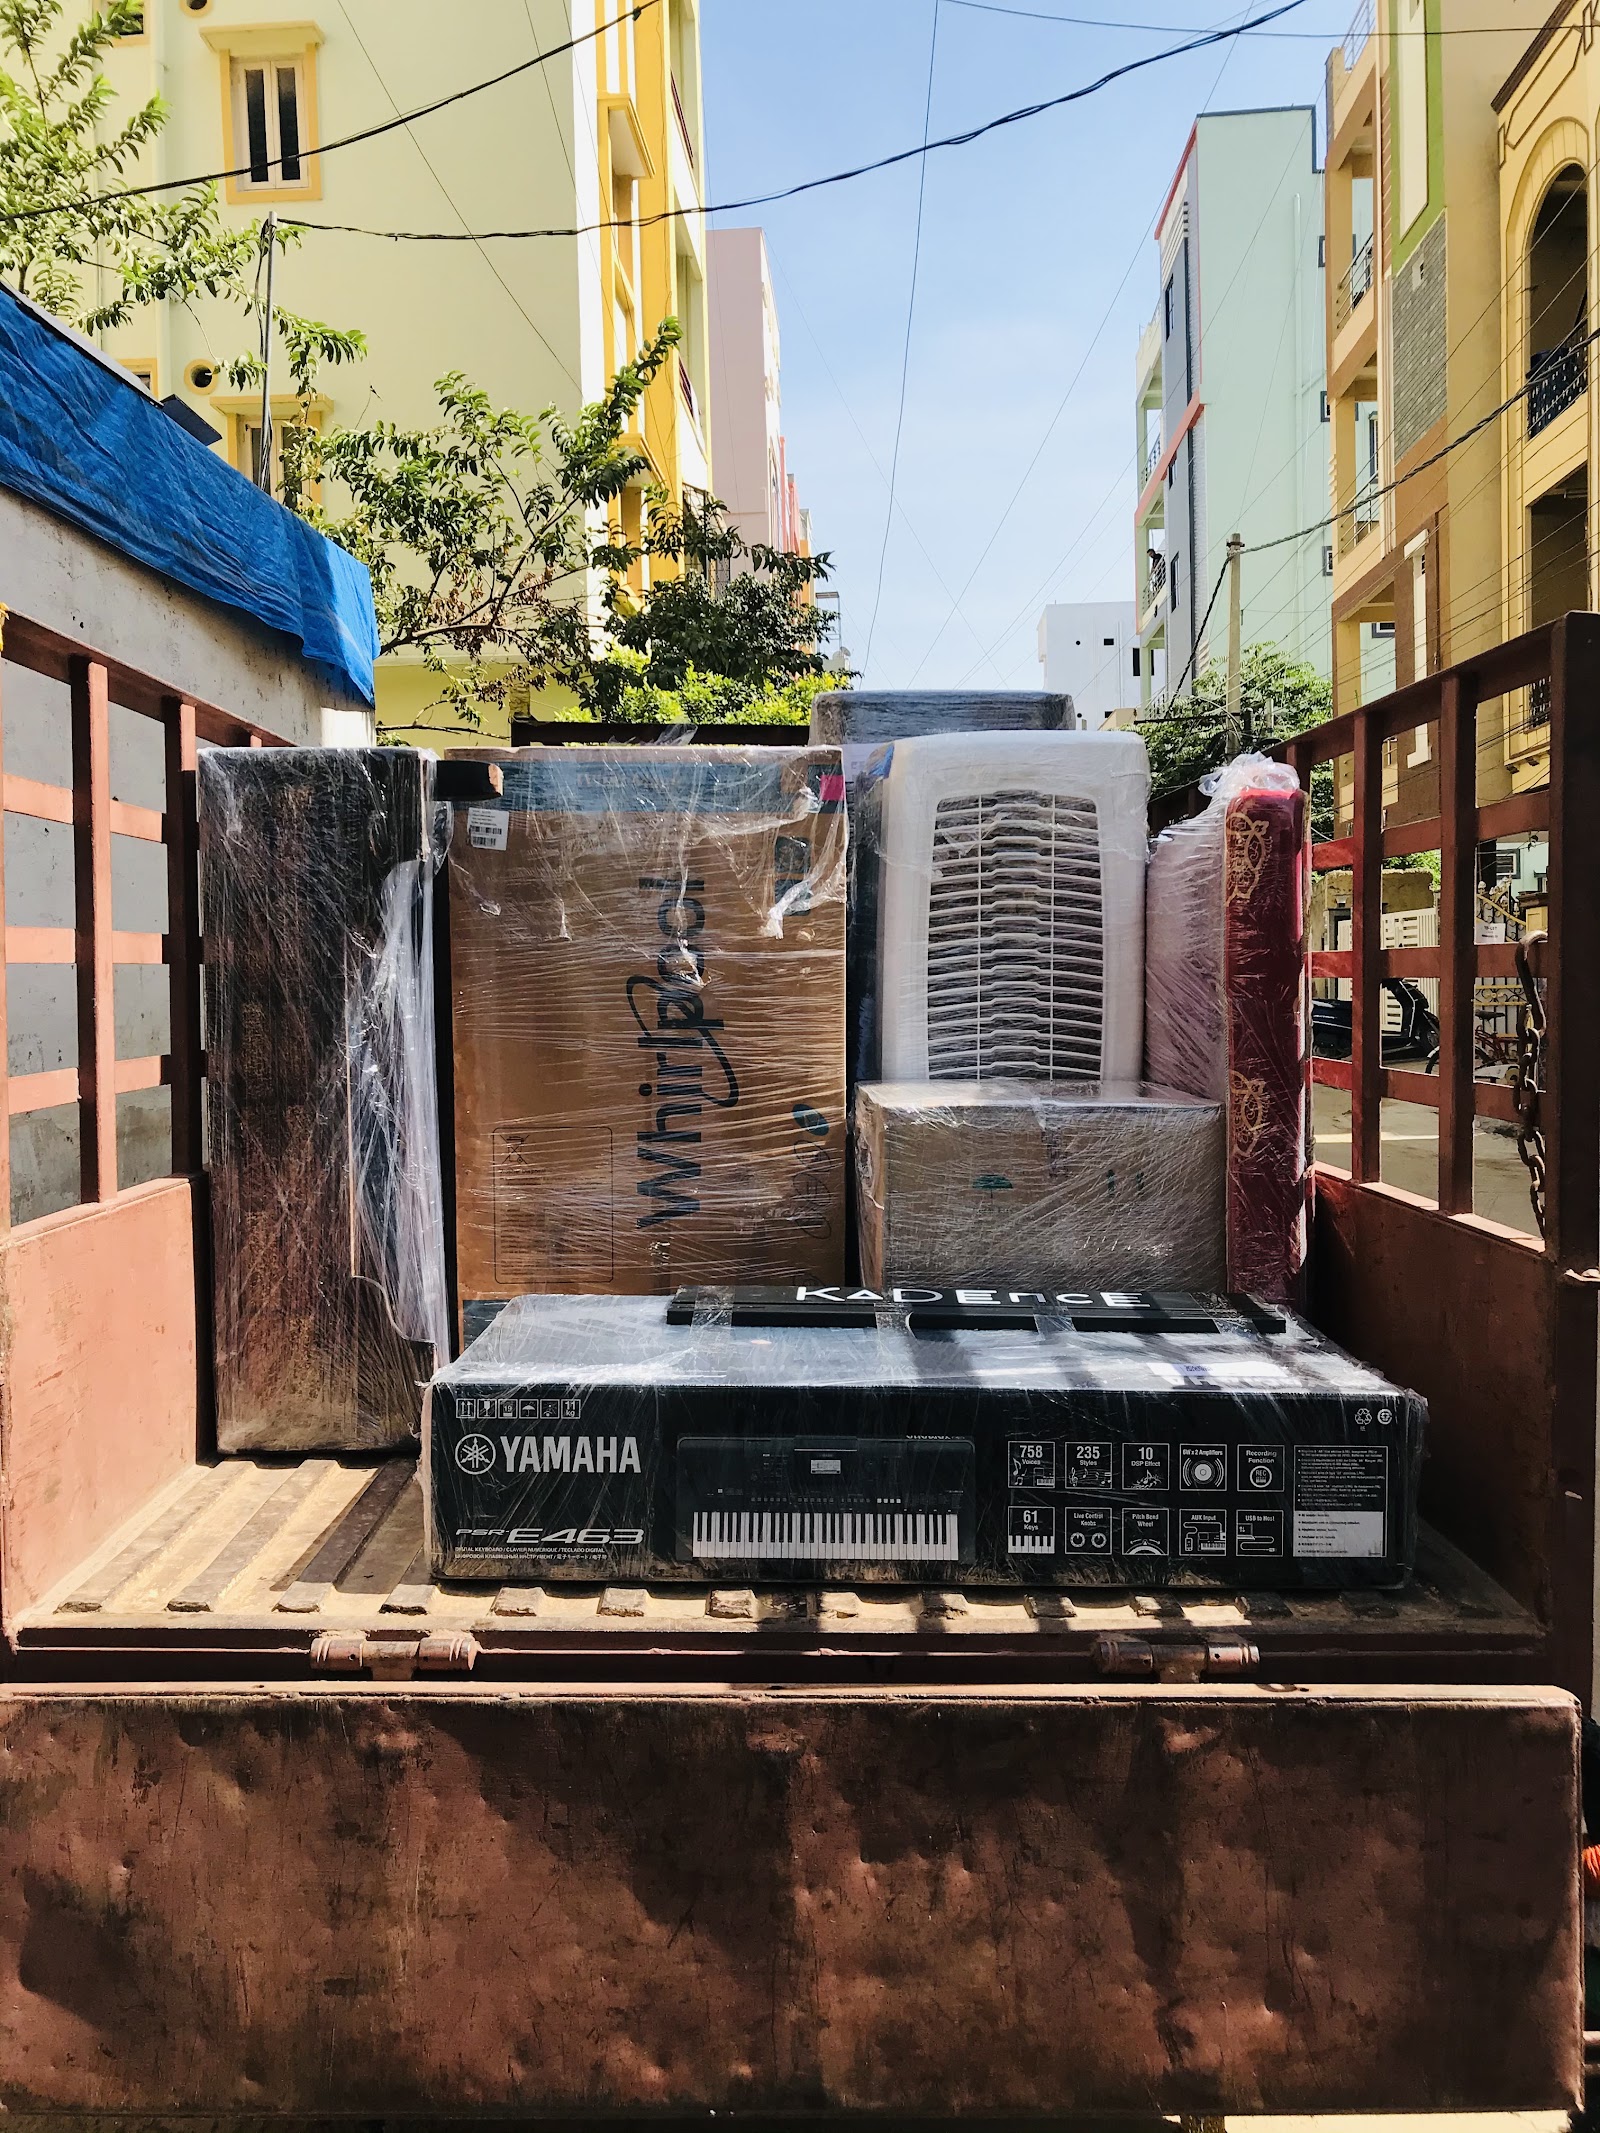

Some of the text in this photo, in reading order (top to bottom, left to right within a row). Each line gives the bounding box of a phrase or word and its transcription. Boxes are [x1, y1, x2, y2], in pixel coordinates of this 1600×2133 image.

[634, 878, 726, 1229] Whirlpool
[564, 1400, 576, 1410] 11
[565, 1409, 576, 1417] kg
[500, 1435, 642, 1474] YAMAHA
[1019, 1445, 1043, 1458] 758
[1076, 1446, 1100, 1459] 235
[1138, 1447, 1154, 1460] 10
[1199, 1448, 1223, 1456] Amplifiers
[1246, 1449, 1277, 1457] Recording
[1079, 1459, 1098, 1467] Styles
[1255, 1469, 1267, 1477] REC
[1023, 1510, 1038, 1524] 61
[1023, 1523, 1039, 1531] Keys
[455, 1528, 645, 1544] PSR-E463
